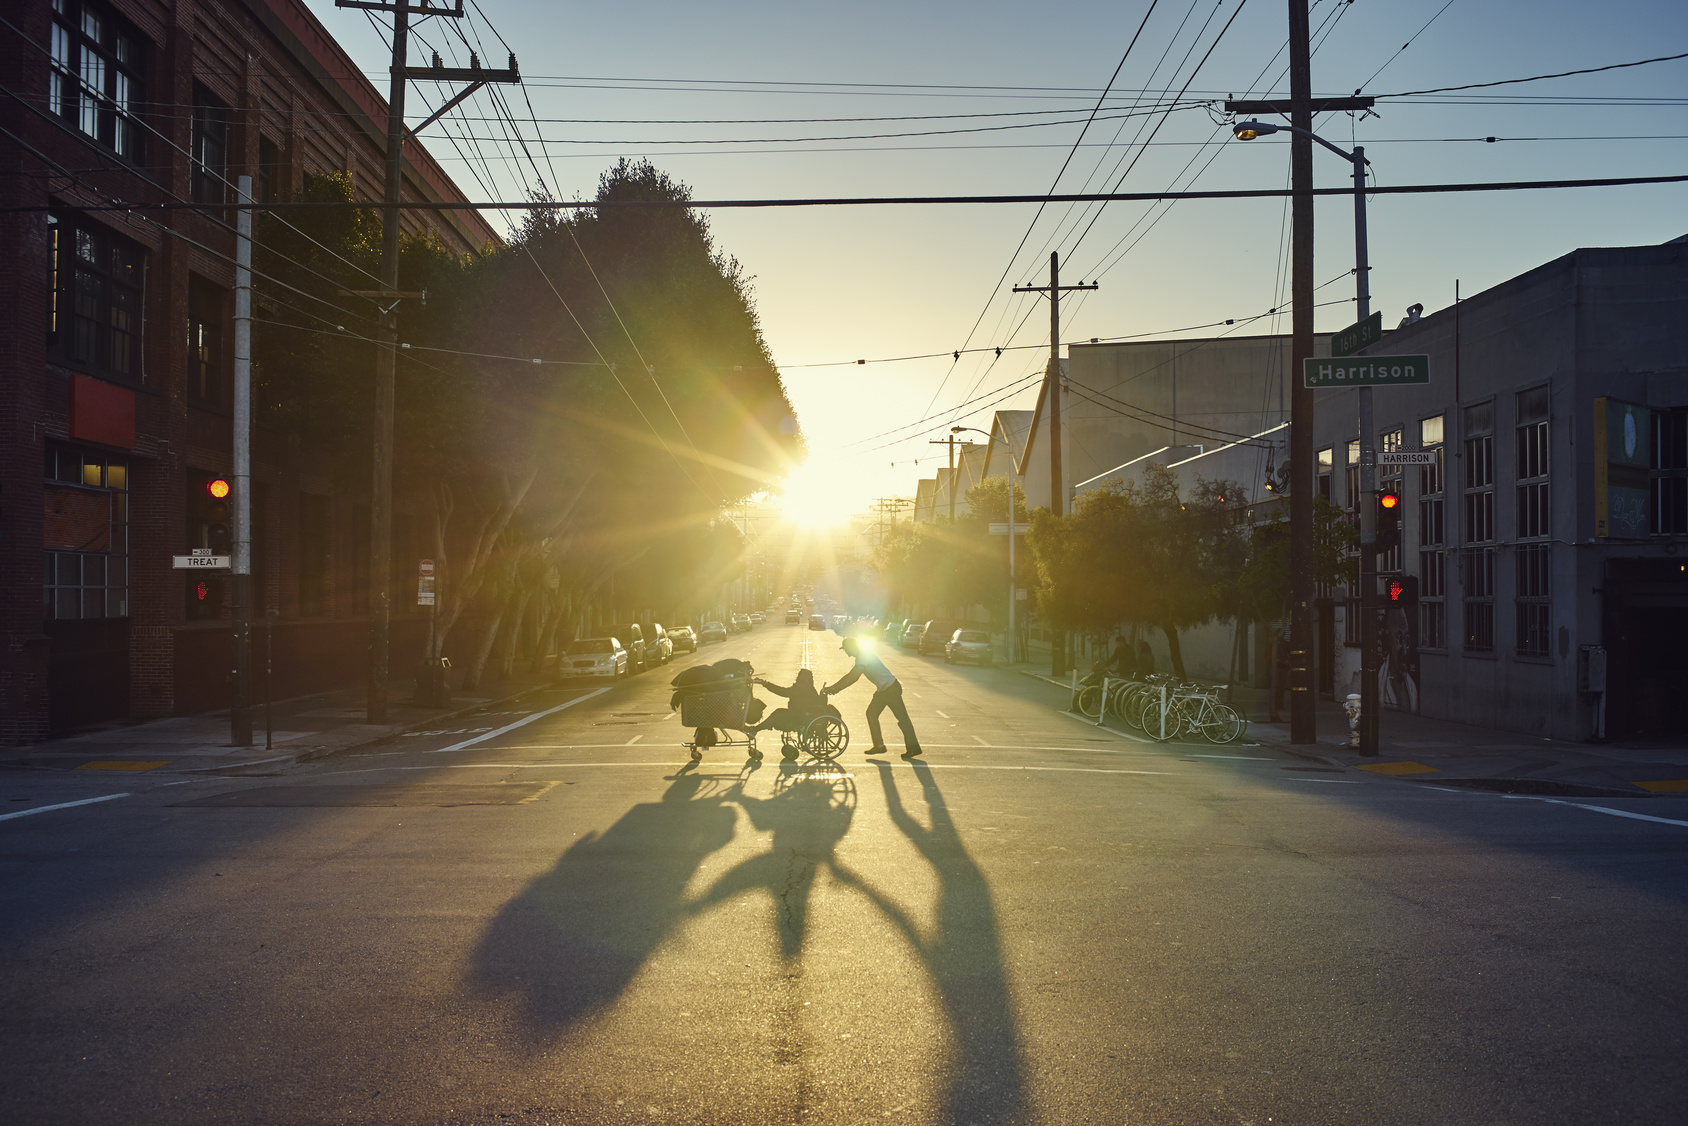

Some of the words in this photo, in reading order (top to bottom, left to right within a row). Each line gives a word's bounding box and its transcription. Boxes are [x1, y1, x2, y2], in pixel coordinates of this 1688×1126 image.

[1340, 332, 1357, 352] 16th
[1362, 325, 1371, 342] St
[1318, 364, 1415, 380] Harrison
[1383, 454, 1429, 463] HARRISON
[187, 558, 218, 566] TREAT
